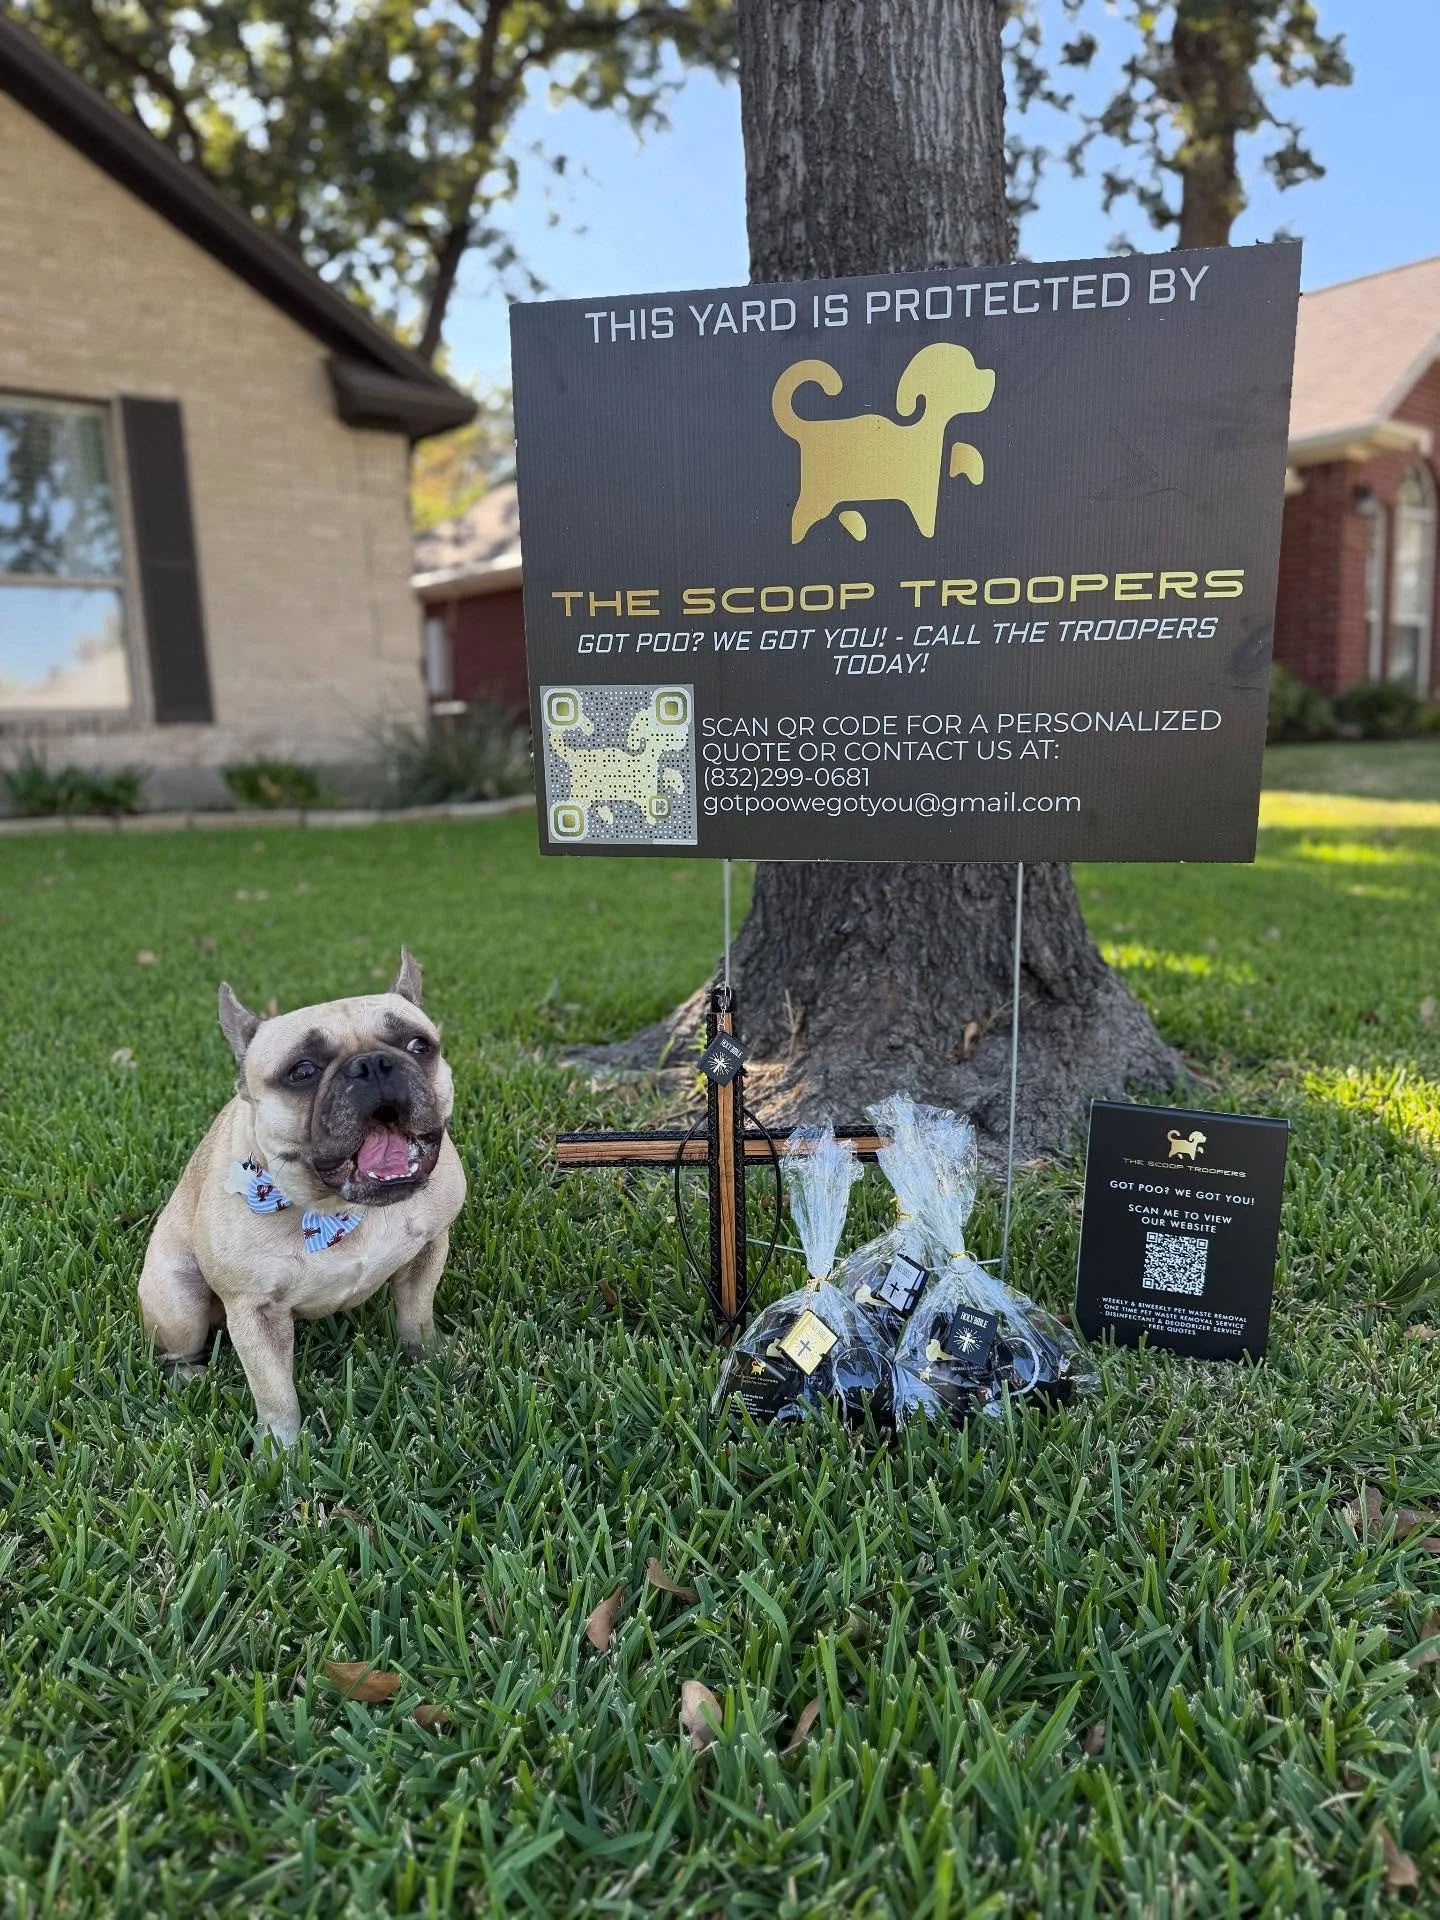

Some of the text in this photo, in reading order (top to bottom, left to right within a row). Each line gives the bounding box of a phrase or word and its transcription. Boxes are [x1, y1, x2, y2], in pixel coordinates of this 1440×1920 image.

[585, 265, 1210, 343] THIS YARD IS PROTECTED BY
[551, 569, 1245, 616] THE SCOOP TROOPERS
[577, 633, 630, 654] GOT
[636, 631, 705, 654] POO?
[712, 630, 753, 652] WE
[759, 629, 816, 650] GOT
[823, 627, 888, 649] YOU!
[913, 624, 982, 646] CALL
[992, 621, 1050, 644] THE
[1058, 617, 1219, 642] TROOPERS
[832, 653, 930, 676] TODAY!
[702, 709, 1222, 739] SCAN QR CODE FOR A PERSONALIZED
[702, 739, 1060, 765] QUOTE OR CONTACT US AT:
[704, 767, 870, 791] (832)299-0681
[703, 791, 1081, 817] gotpoowegotyou@gmail.com
[1122, 1157, 1247, 1178] THE SCOOP TROOPERS
[1109, 1180, 1135, 1191] GOT
[1174, 1188, 1192, 1198] WE
[1195, 1191, 1221, 1201] GOT
[1225, 1194, 1255, 1206] YOU!
[1128, 1203, 1232, 1224] SCAN ME TO VIEW
[1141, 1216, 1217, 1234] OUR WEBSITE
[1101, 1296, 1128, 1305] WEEKLY
[1138, 1302, 1172, 1312] BIWEEKLY
[1188, 1309, 1212, 1318] WASTE
[1213, 1313, 1247, 1323] REMOVAL
[1103, 1303, 1119, 1311] ONE
[1122, 1306, 1138, 1314] TIME
[1154, 1311, 1178, 1320] WASTE
[1179, 1315, 1213, 1325] REMOVAL
[1215, 1320, 1244, 1330] SERVICE
[1104, 1310, 1155, 1323] DISINFECTANT
[1165, 1319, 1211, 1331] DEODORIZER
[1212, 1326, 1242, 1336] SERVICE
[1148, 1323, 1196, 1336] FREE QUOTES
